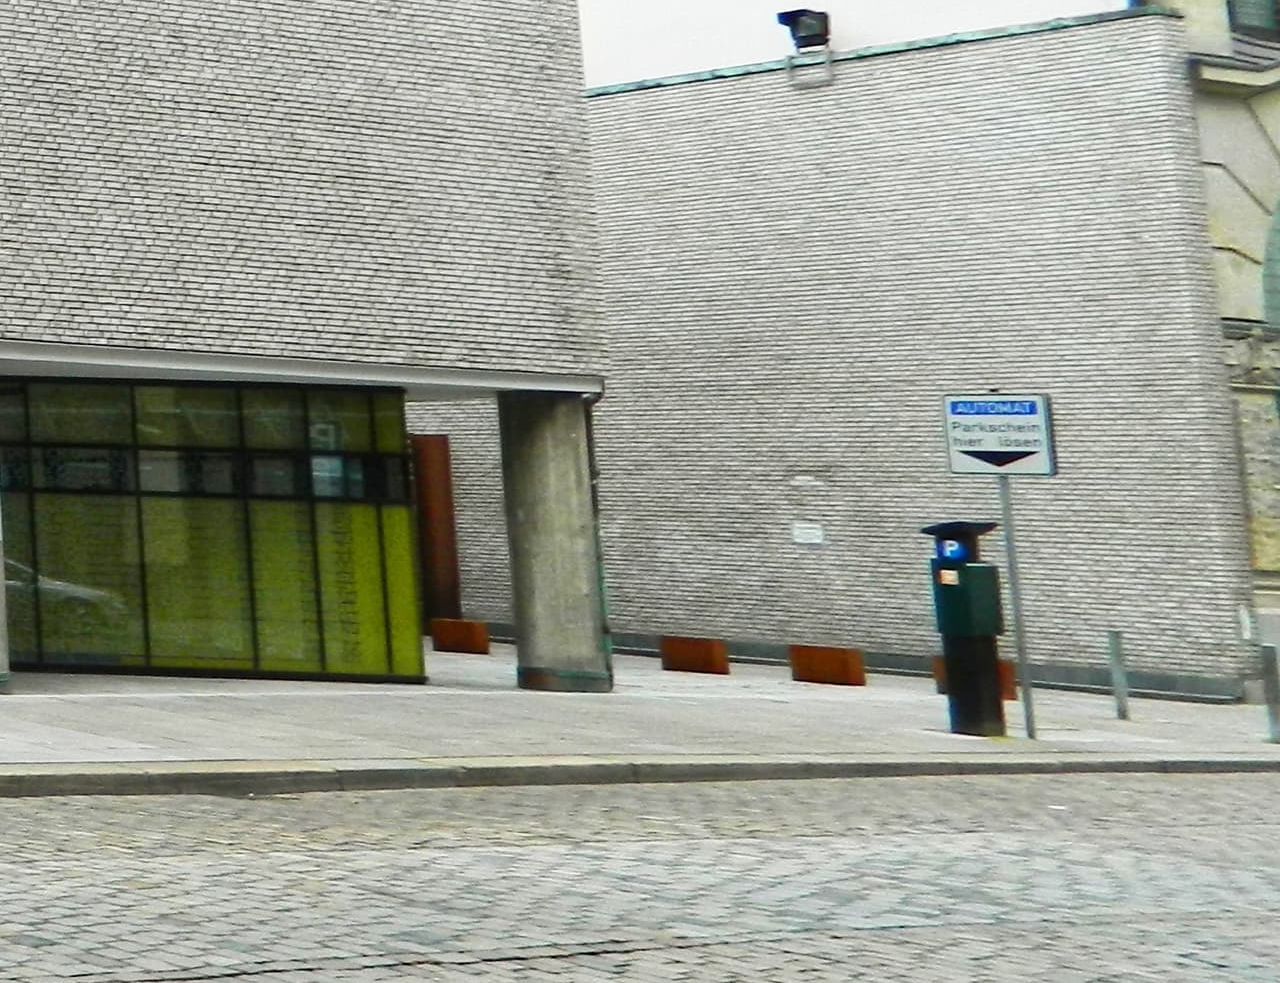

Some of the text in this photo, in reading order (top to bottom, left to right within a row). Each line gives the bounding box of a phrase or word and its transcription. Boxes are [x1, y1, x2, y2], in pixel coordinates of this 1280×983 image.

[956, 401, 1033, 414] AUTOMAT
[951, 421, 1040, 433] Parkschein
[952, 436, 983, 447] hier
[942, 539, 959, 557] P
